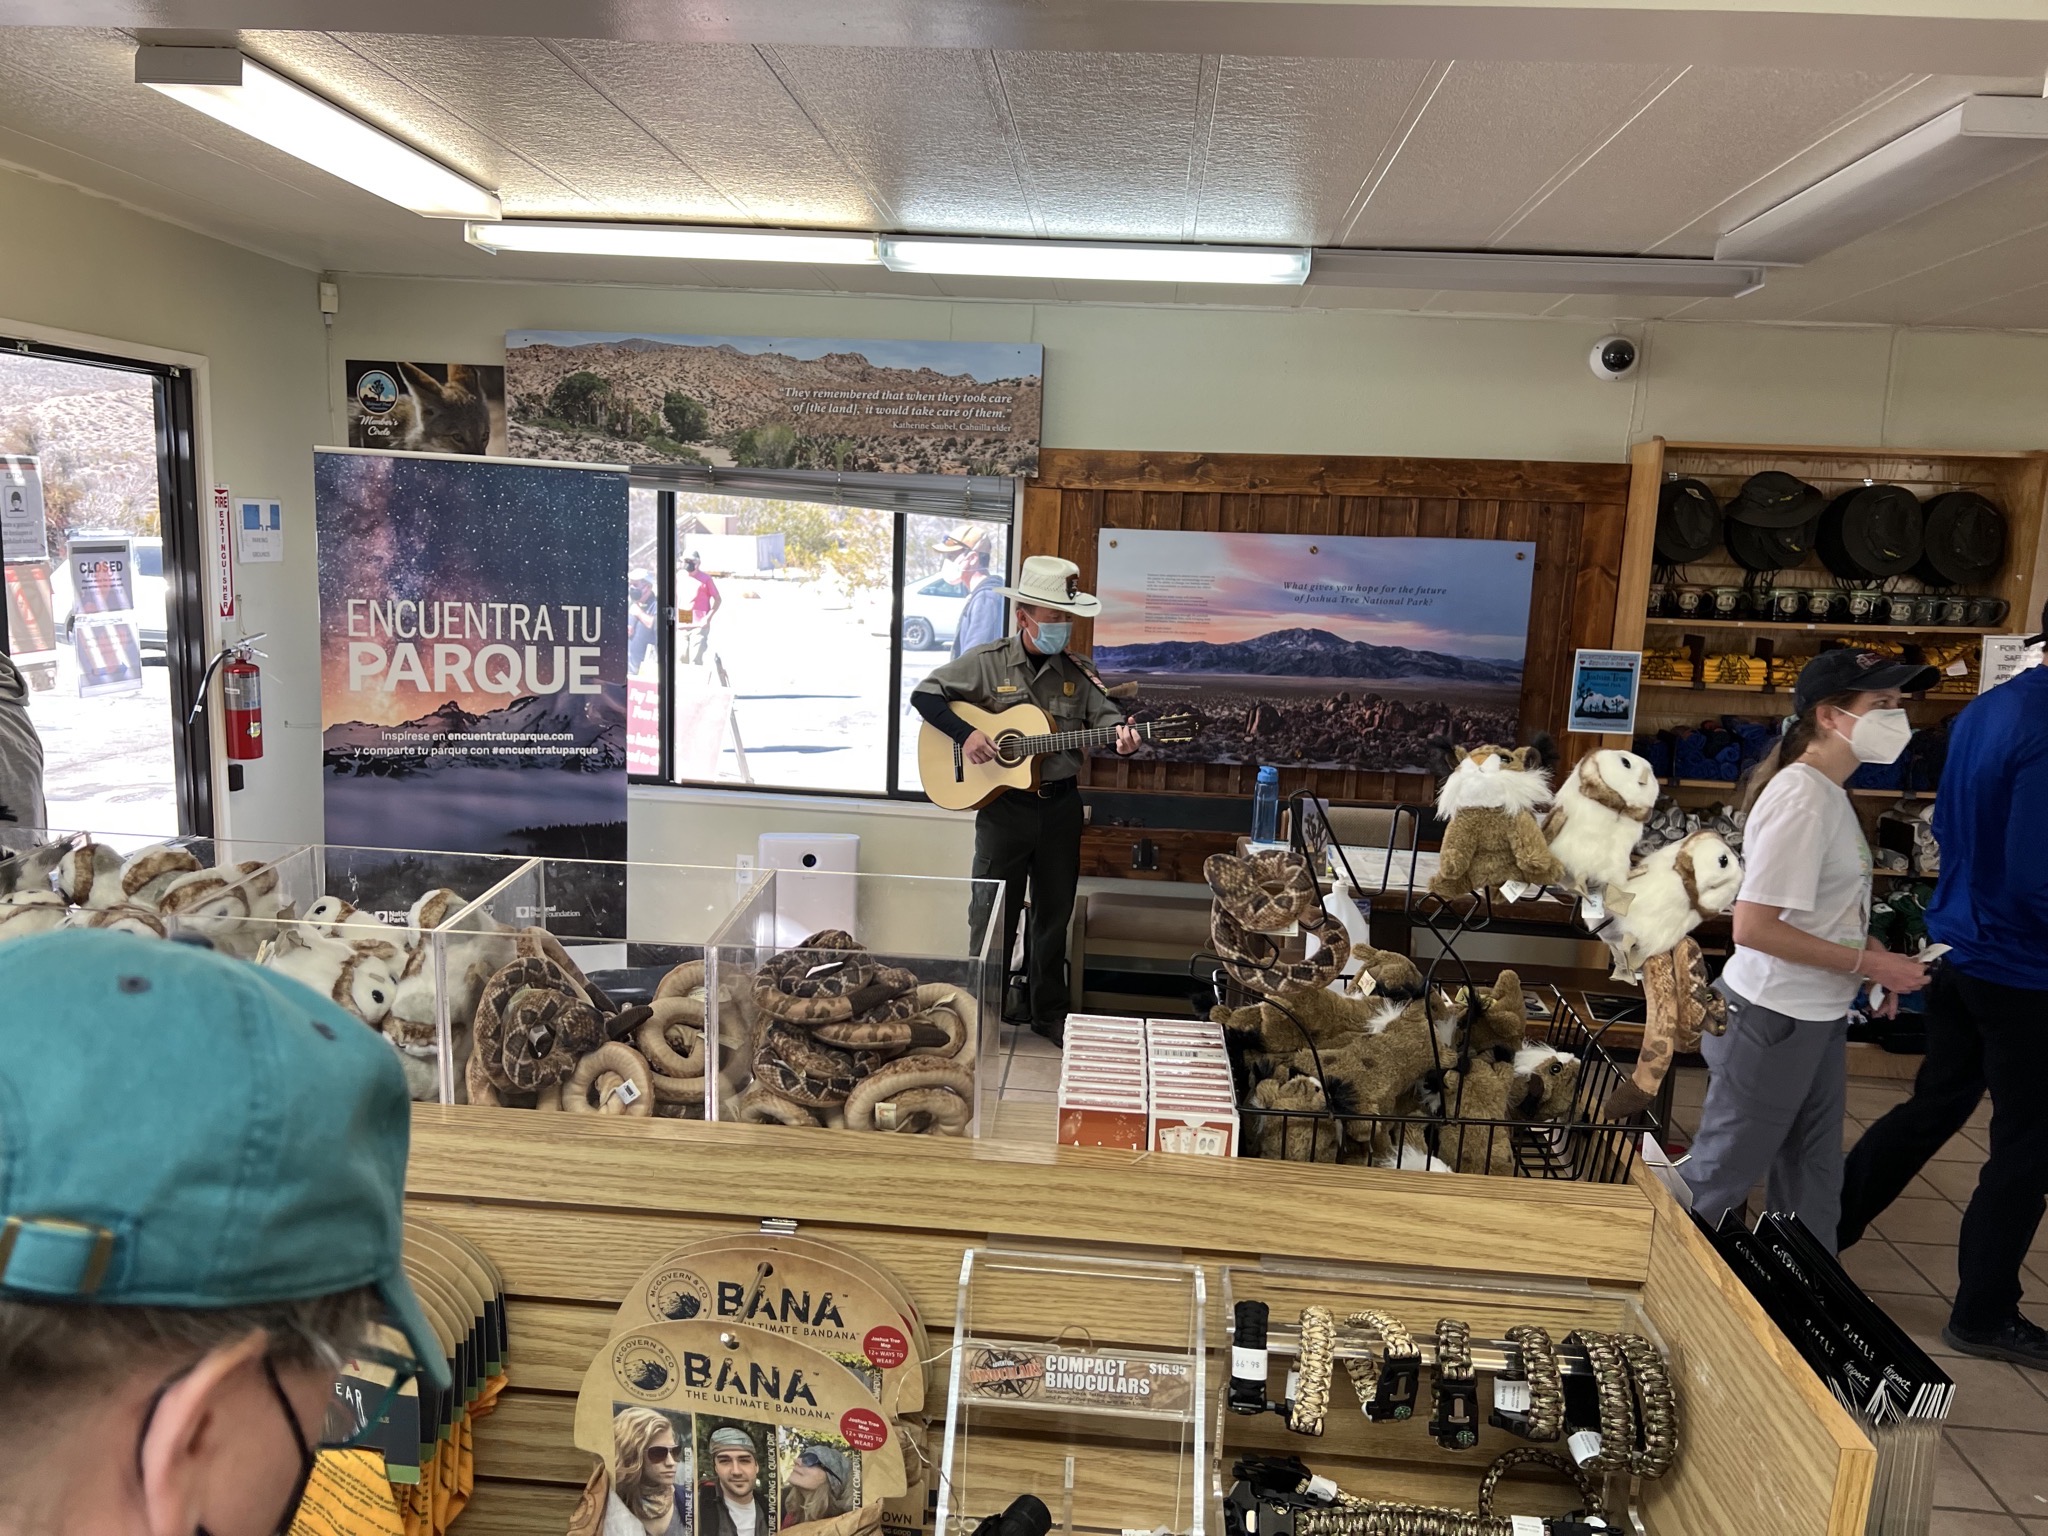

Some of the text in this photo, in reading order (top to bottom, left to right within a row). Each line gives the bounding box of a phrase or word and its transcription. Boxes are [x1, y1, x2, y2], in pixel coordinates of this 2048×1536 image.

[813, 388, 880, 401] remembered
[881, 390, 904, 401] that
[906, 391, 935, 402] when
[937, 391, 961, 404] they
[963, 393, 987, 403] took
[988, 395, 1013, 404] care
[792, 403, 804, 415] of
[865, 404, 874, 415] it
[875, 404, 909, 416] would
[911, 406, 935, 416] take
[936, 408, 960, 417] care
[962, 406, 974, 419] of
[892, 421, 930, 430] Katherine
[992, 424, 1012, 432] elder
[214, 496, 228, 509] FIRE
[79, 560, 123, 574] CLOSED
[219, 510, 229, 609] EXTINGUISHER
[1283, 581, 1447, 595] What gives you hope for the future
[1294, 594, 1433, 607] of Joshua Tree National Park?
[347, 599, 602, 643] ENCUENTRA TU
[349, 641, 602, 697] PARQUE
[432, 733, 446, 741] en
[447, 731, 574, 742] encuentratuparque.com
[354, 746, 599, 757] y comparte tu parque con #encuentratuparque
[880, 1350, 896, 1358] WAYS
[1045, 1355, 1187, 1376] COMPACT $16.95
[1235, 1360, 1260, 1369] $6.99
[1843, 1361, 1871, 1388] impact
[1884, 1364, 1911, 1392] impact
[1045, 1372, 1150, 1395] BINOCULARS
[685, 1389, 708, 1400] THE
[713, 1393, 770, 1411] ULTIMATE
[848, 1417, 880, 1428] Joshua Tree
[766, 1431, 775, 1447] DRY
[858, 1432, 875, 1440] WAYS
[768, 1450, 777, 1470] QUICK
[768, 1481, 777, 1514] WICKING
